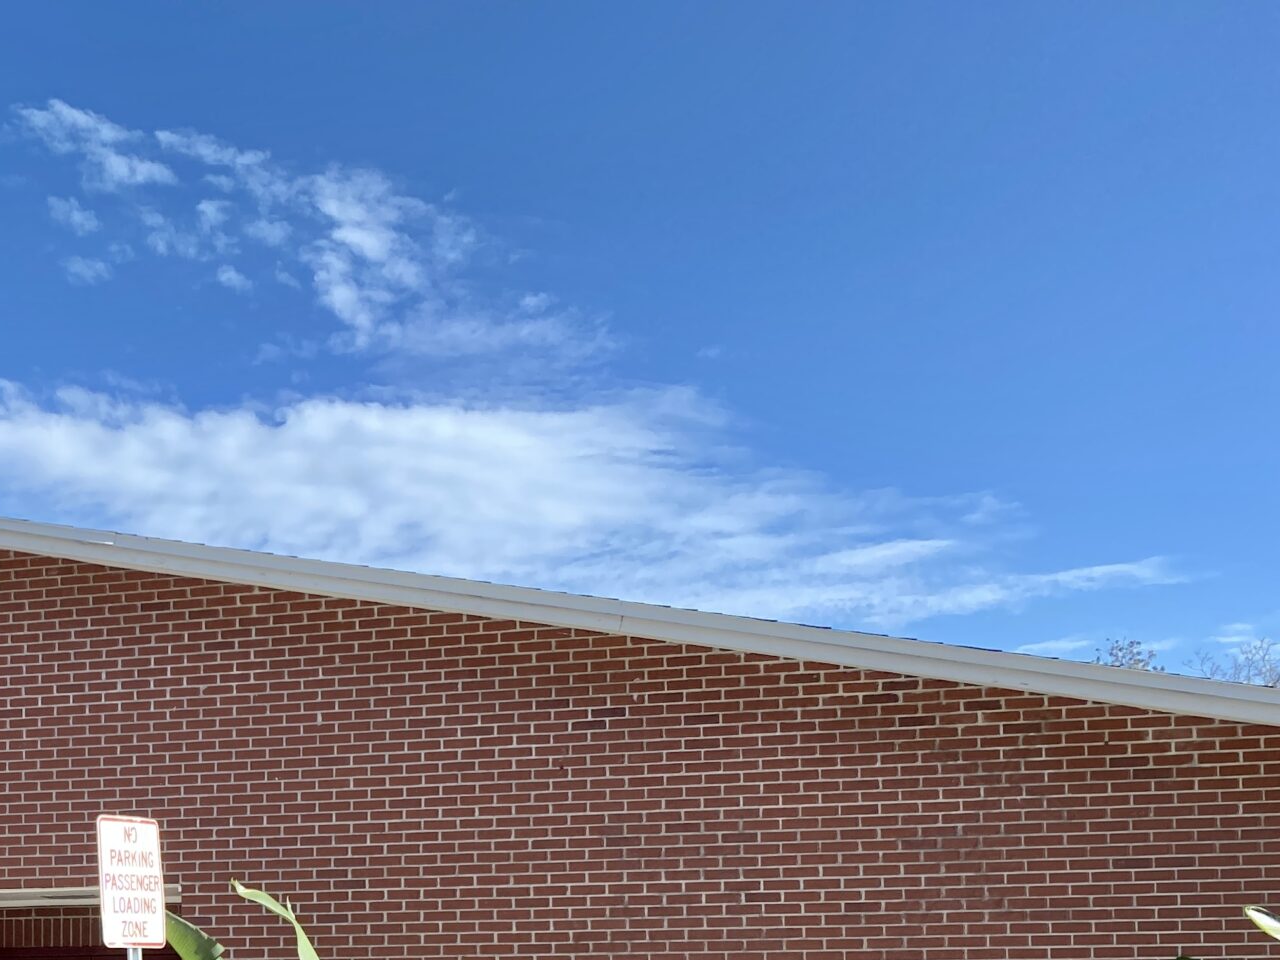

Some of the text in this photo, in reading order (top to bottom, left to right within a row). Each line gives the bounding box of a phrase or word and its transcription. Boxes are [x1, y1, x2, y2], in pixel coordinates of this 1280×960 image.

[123, 826, 138, 844] NO
[109, 849, 154, 868] PARKING
[104, 873, 160, 892] PASSENGER
[113, 896, 157, 914] LOADING
[121, 920, 149, 938] ZONE
